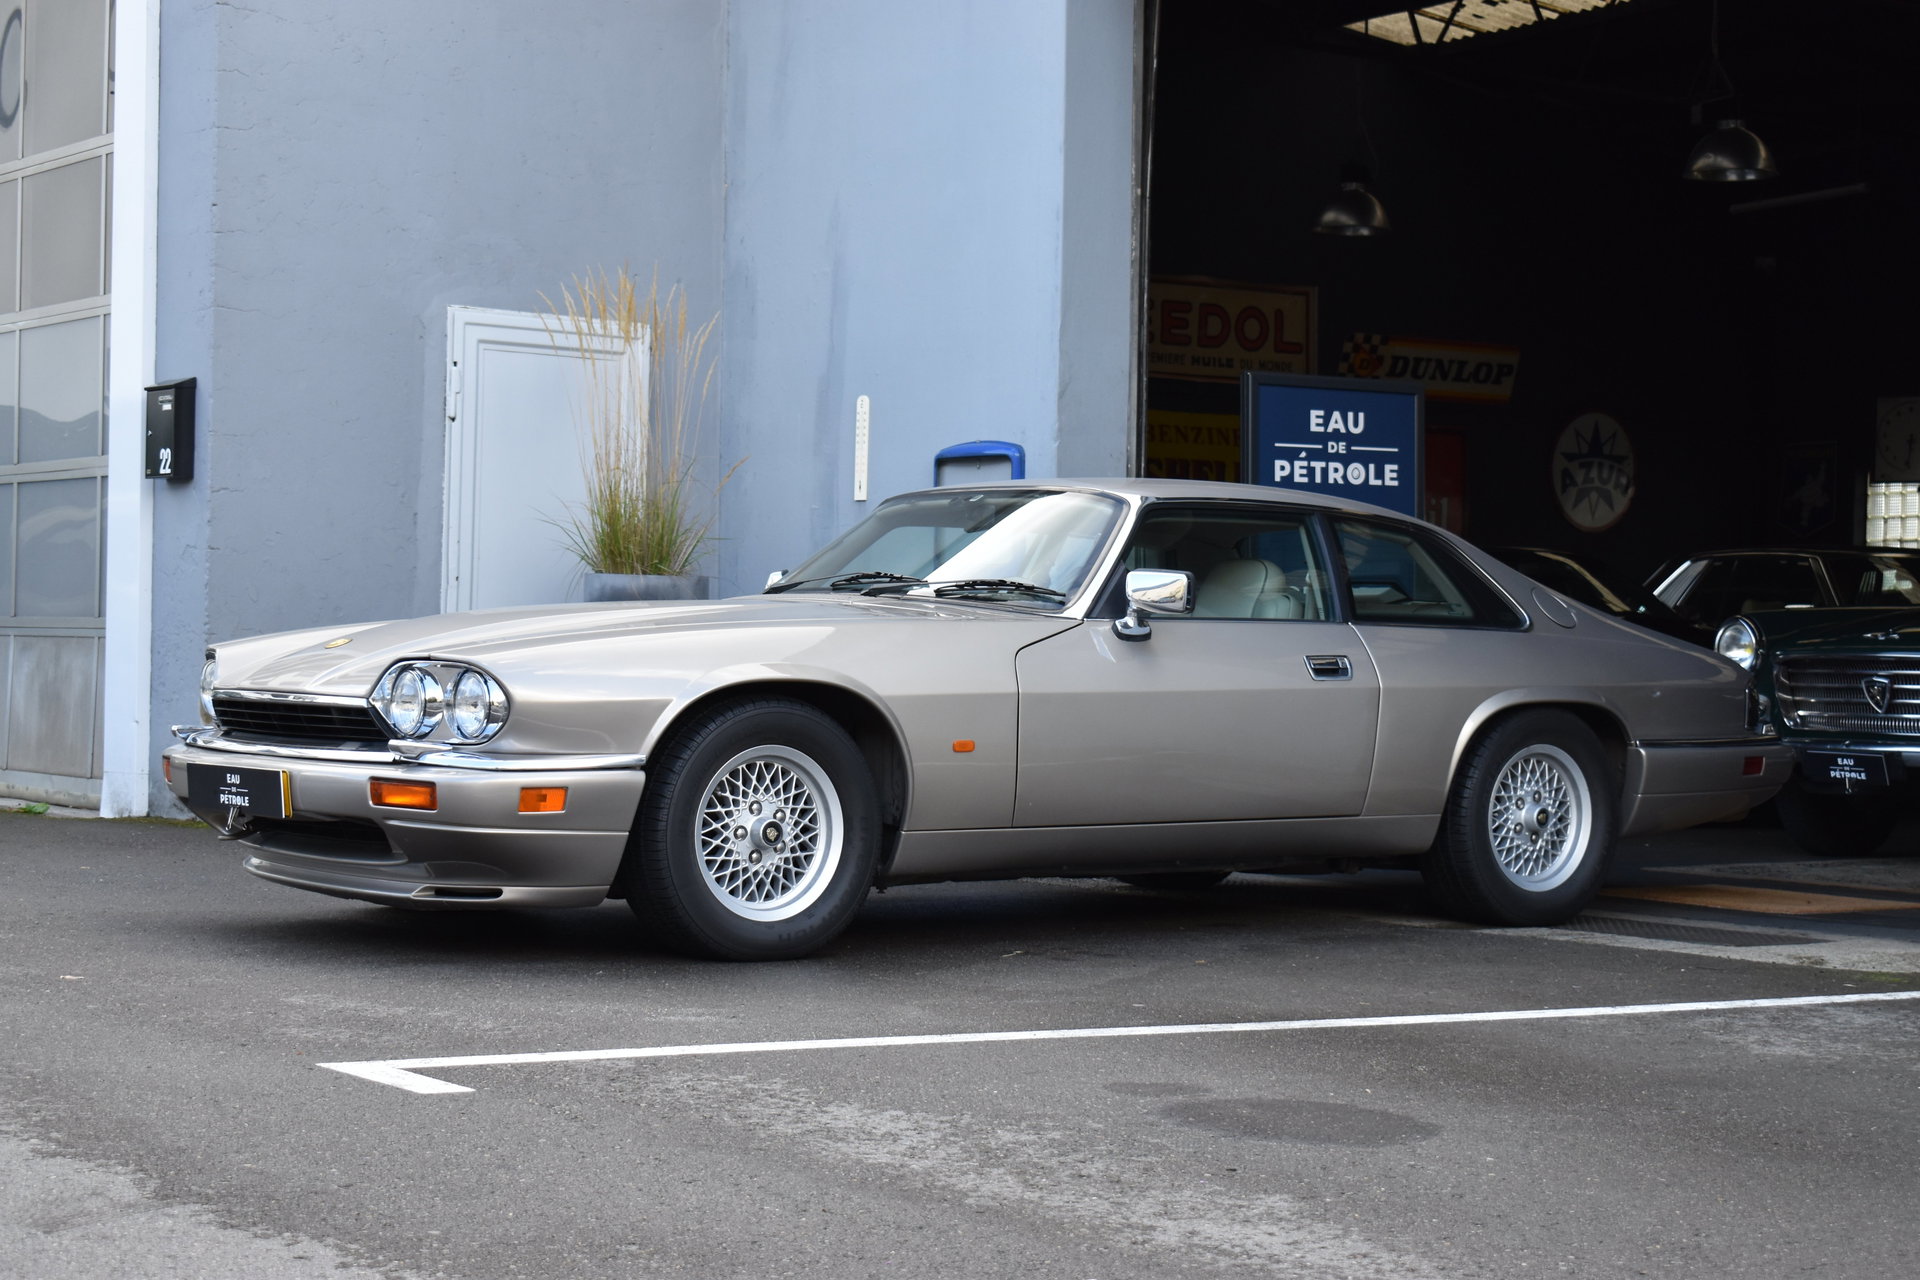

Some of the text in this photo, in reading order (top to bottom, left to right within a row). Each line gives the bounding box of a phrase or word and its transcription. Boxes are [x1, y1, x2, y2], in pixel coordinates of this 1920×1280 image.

[1149, 297, 1303, 354] EDOL
[1191, 355, 1235, 369] HUILE
[1240, 359, 1253, 370] DU
[1259, 359, 1294, 372] MONDE
[1387, 355, 1514, 384] DUNLOP
[1309, 409, 1365, 434] EAU
[1327, 441, 1347, 454] DE
[159, 447, 172, 475] 22
[1274, 450, 1399, 487] PÉTROLE
[1560, 460, 1631, 496] AZUR
[1836, 757, 1855, 766] EAU
[226, 773, 240, 784] EAU
[220, 791, 249, 806] PÉTROLE
